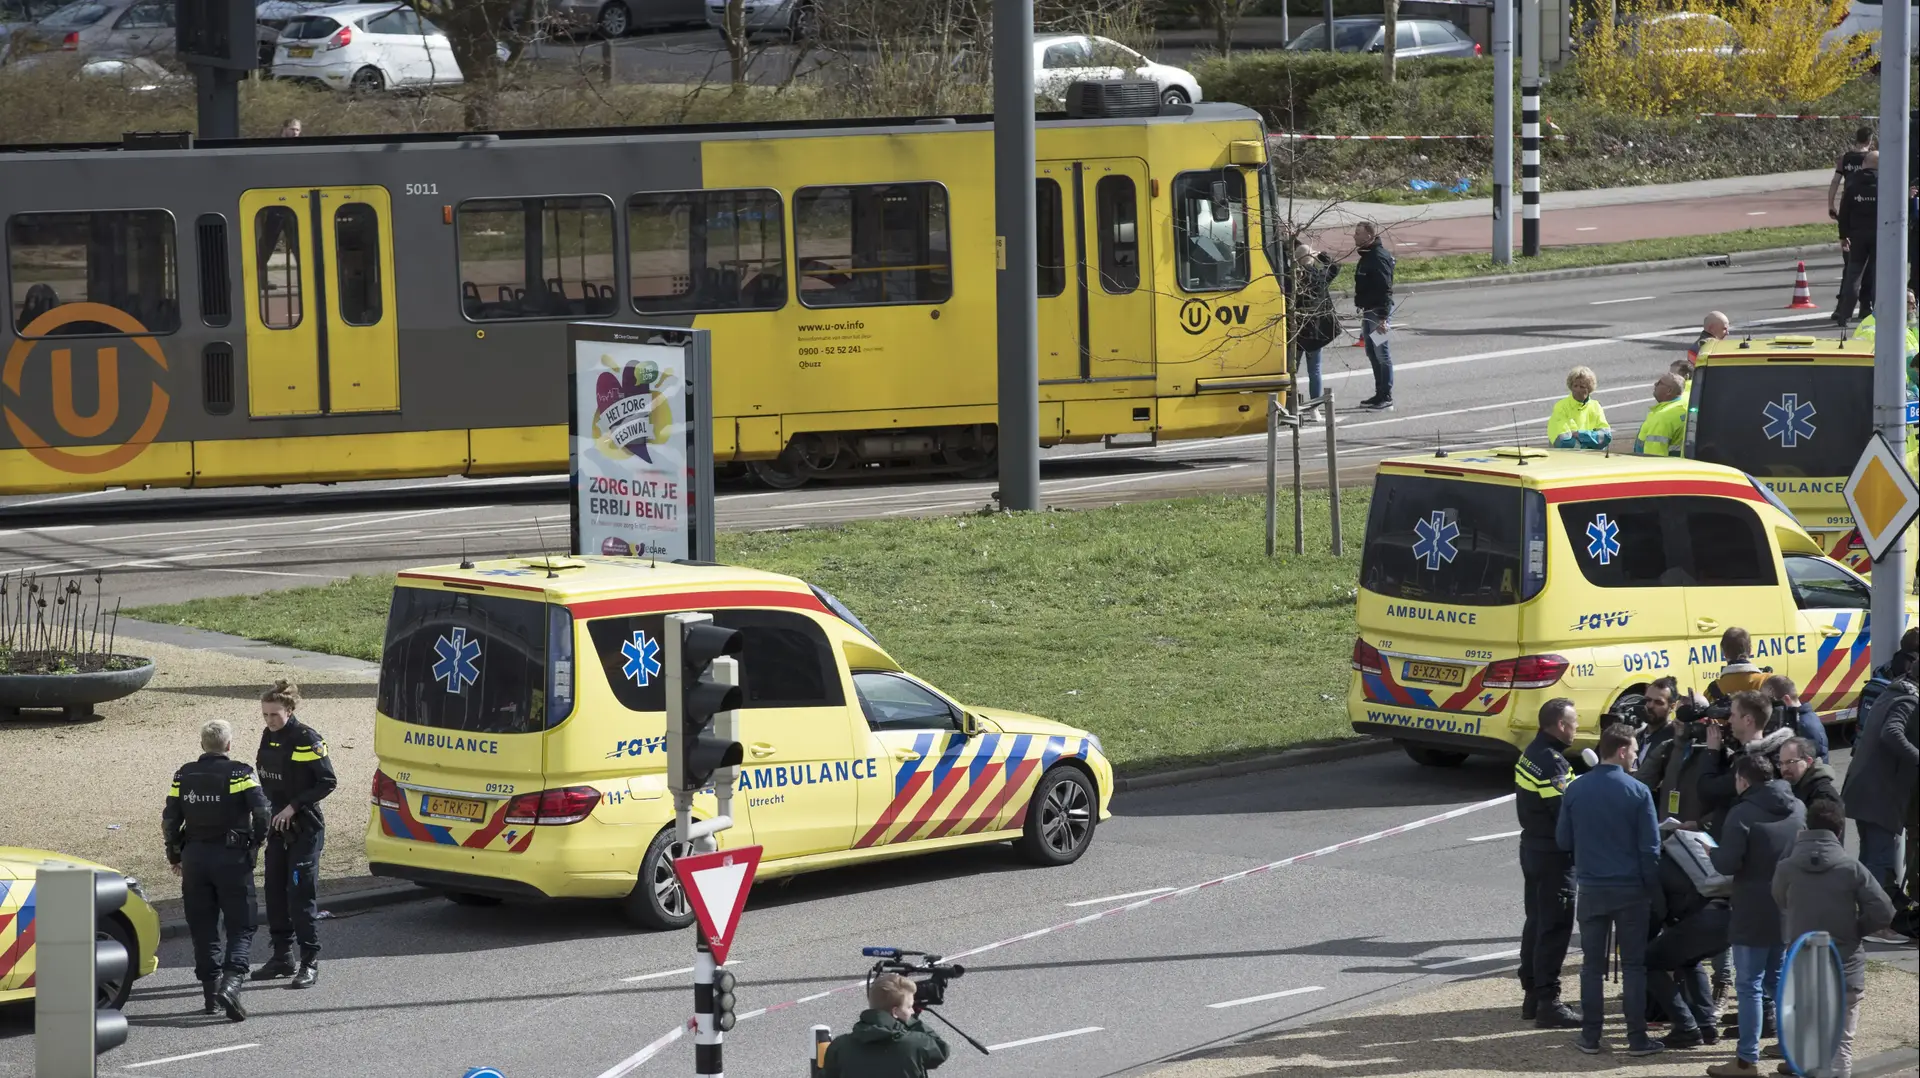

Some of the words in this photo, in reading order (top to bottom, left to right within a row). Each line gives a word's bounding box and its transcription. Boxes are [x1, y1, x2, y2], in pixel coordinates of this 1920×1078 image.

[406, 183, 439, 195] 5011
[798, 320, 865, 332] www.u-ov.info
[798, 347, 819, 356] 0900
[825, 347, 835, 355] 52
[837, 346, 847, 354] 52
[848, 345, 861, 354] 241
[798, 361, 822, 370] Qbuzz
[51, 347, 119, 437] U
[606, 407, 620, 424] HET
[621, 398, 646, 415] ZORG
[614, 421, 647, 445] FESTIVAL
[589, 477, 628, 496] ZORG
[632, 480, 658, 498] DAT
[661, 482, 678, 499] JE
[590, 498, 630, 517] ERBIJ
[635, 501, 677, 520] BENT!
[1386, 604, 1477, 625] AMBULANCE
[1578, 610, 1631, 631] ravu
[1465, 649, 1492, 659] 09125
[1688, 634, 1806, 665] AMANCE
[1623, 649, 1670, 672] 09125
[1412, 665, 1459, 680] 8-XZX-79
[1702, 671, 1720, 680] Utre
[1367, 710, 1482, 735] www.ravu.nl
[404, 731, 498, 754] AMBULANCE
[738, 758, 878, 792] AMBULANCE
[183, 789, 220, 804] POLITIE
[485, 783, 515, 794] 09123
[432, 800, 479, 816] 6-TRK-17
[750, 794, 785, 807] Utrecht
